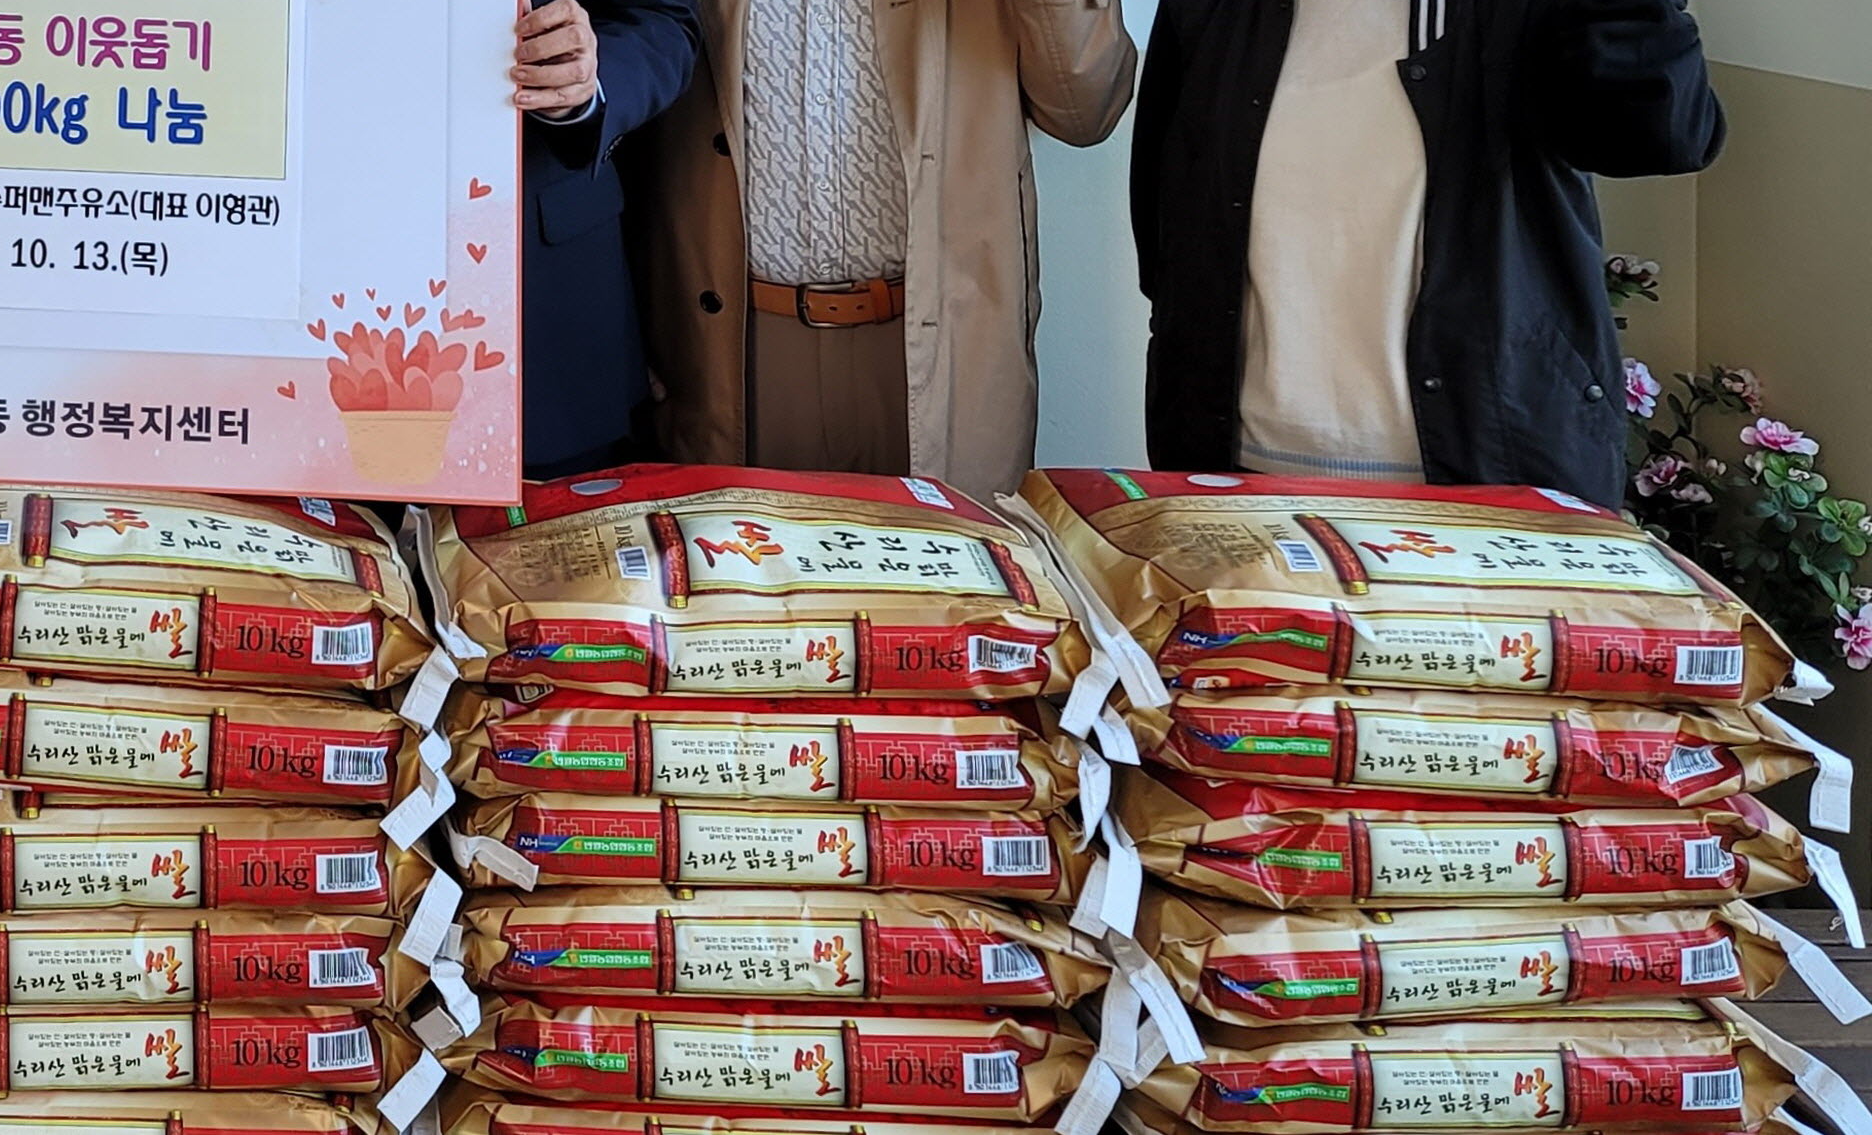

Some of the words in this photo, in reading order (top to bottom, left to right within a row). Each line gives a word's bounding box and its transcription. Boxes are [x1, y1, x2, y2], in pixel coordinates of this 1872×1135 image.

[46, 15, 213, 73] 이웃돕기
[116, 89, 208, 144] 나눔
[11, 238, 55, 269] 10.
[73, 240, 169, 277] 13.(목)
[22, 398, 252, 447] 행정복지센터
[18, 625, 70, 647] 수리산
[149, 608, 191, 657] 쌀
[673, 662, 725, 681] 수리산
[806, 636, 850, 682] 쌀
[1356, 649, 1412, 673] 수리산
[1500, 633, 1542, 682] 쌀
[519, 836, 539, 849] NH
[685, 851, 736, 871] 수리산
[818, 828, 861, 876] 쌀
[1377, 862, 1433, 886] 수리산
[1516, 841, 1561, 886] 쌀
[19, 876, 70, 896] 수리산
[152, 849, 195, 900] 쌀
[13, 972, 66, 993] 수리산
[145, 945, 189, 995] 쌀
[680, 962, 733, 982] 수리산
[814, 936, 859, 987] 쌀
[1377, 1094, 1433, 1119] 수리산
[1514, 1068, 1559, 1116] 쌀
